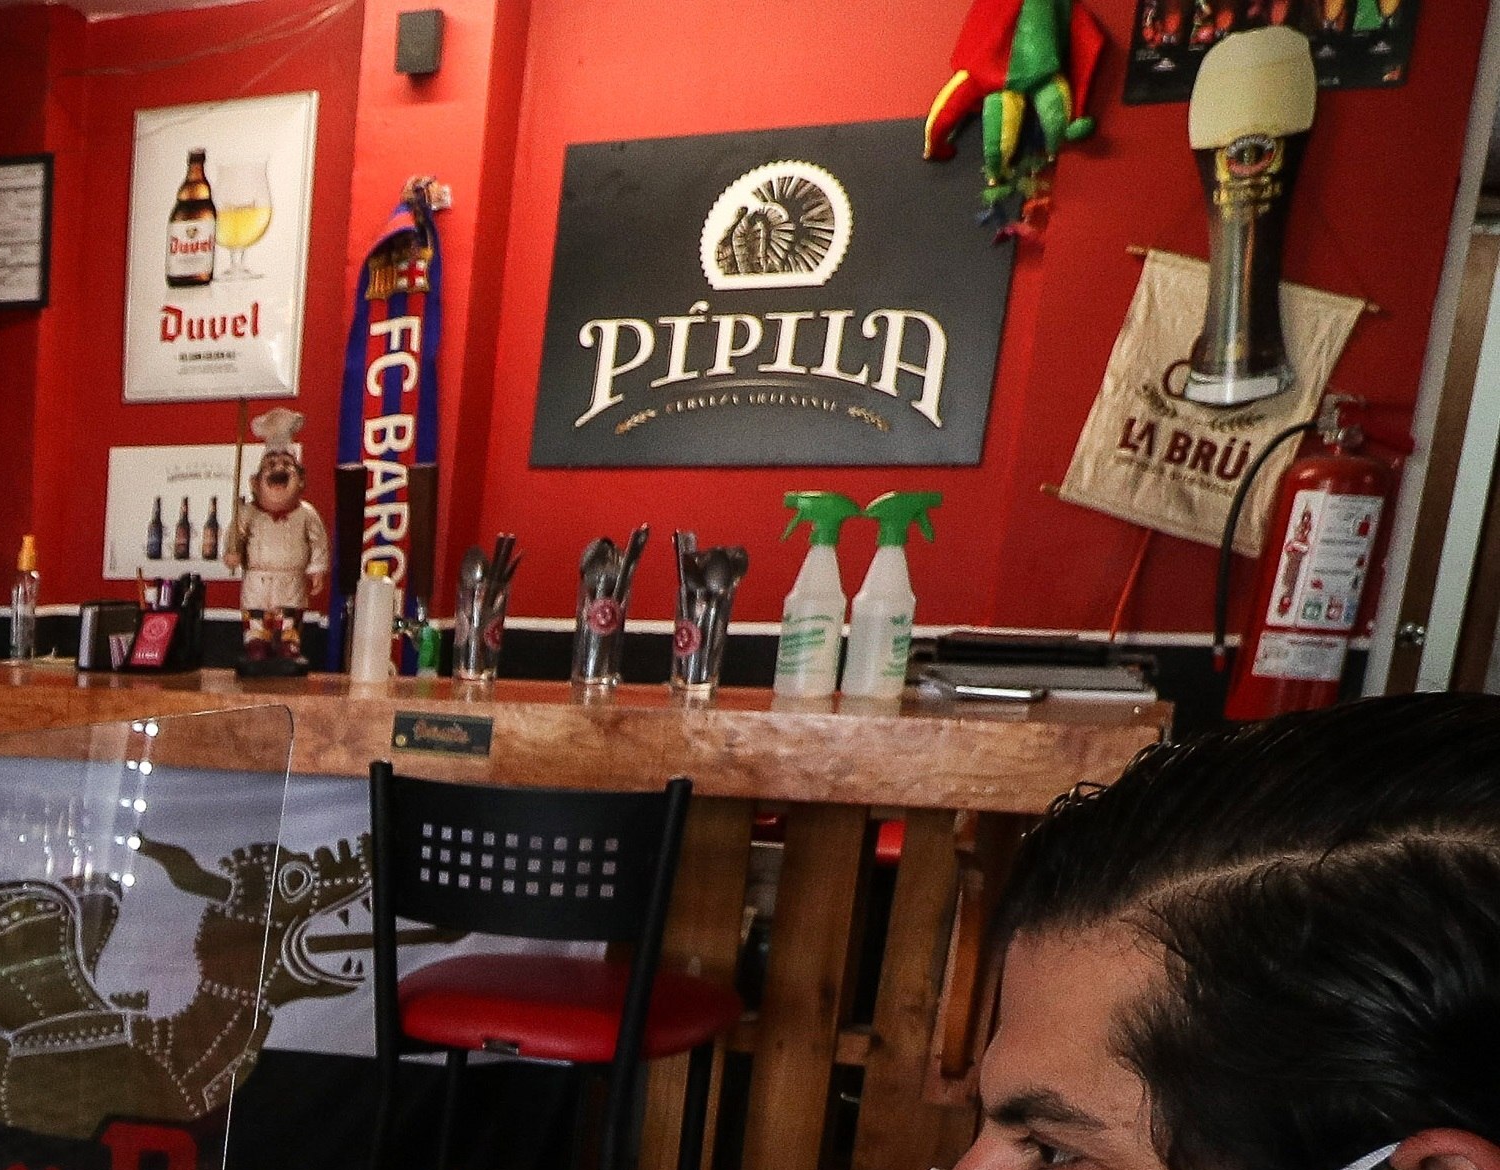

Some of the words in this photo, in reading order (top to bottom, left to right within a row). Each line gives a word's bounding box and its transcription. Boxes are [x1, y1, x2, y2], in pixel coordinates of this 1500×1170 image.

[160, 302, 260, 342] Duvel
[366, 315, 421, 397] FC
[1118, 417, 1157, 457] LA
[1165, 427, 1252, 482] BRÜ
